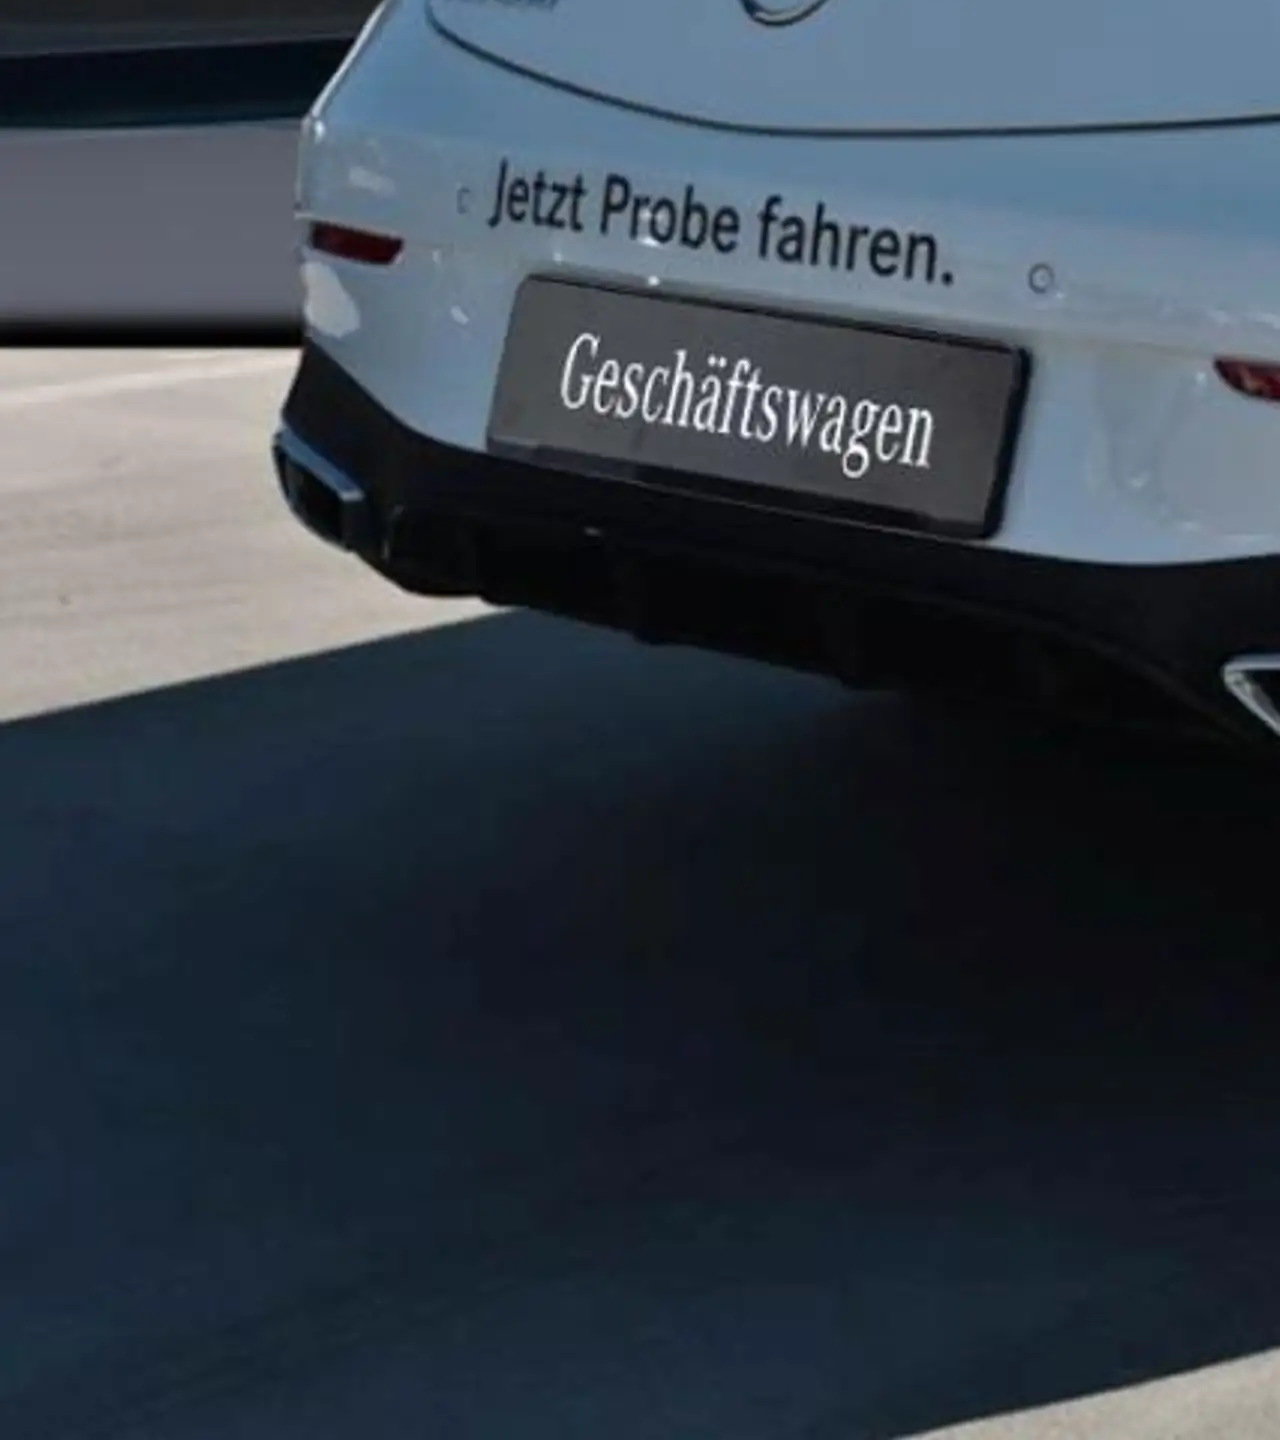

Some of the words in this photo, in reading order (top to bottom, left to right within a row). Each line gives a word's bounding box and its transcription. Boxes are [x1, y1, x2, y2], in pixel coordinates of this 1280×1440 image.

[488, 157, 588, 233] Jetzt
[600, 173, 740, 255] Probe
[758, 194, 955, 286] fahren.
[559, 332, 936, 479] Geschäftswagen
